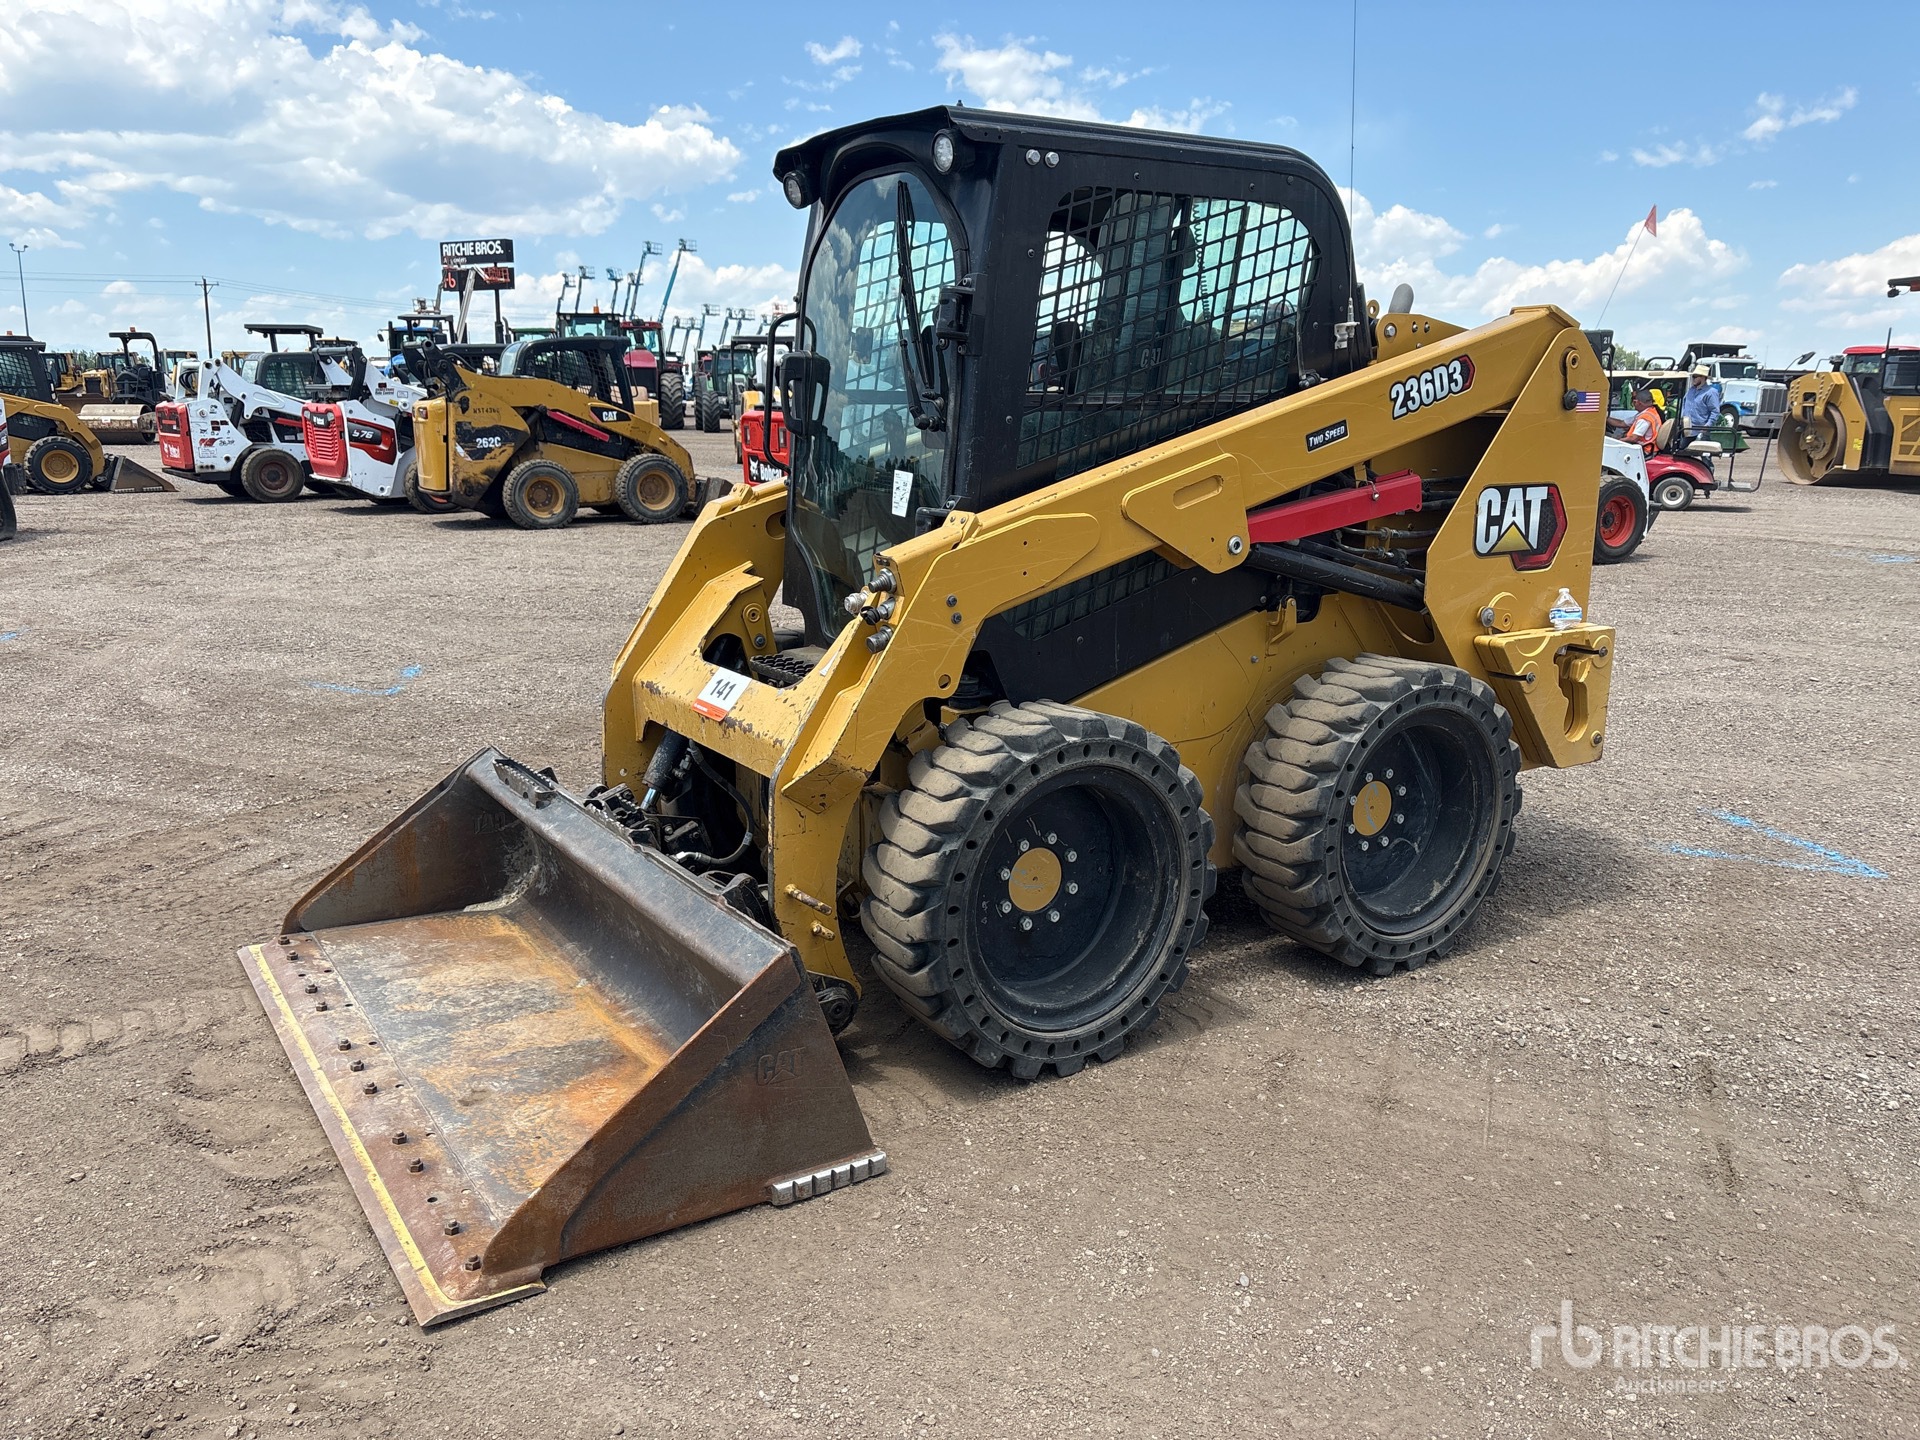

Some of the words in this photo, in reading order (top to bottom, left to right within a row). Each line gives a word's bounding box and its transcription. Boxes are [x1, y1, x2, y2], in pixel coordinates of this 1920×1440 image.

[442, 241, 474, 257] RITCHIE
[475, 240, 504, 256] BROS.
[1603, 336, 1611, 345] 21
[1390, 359, 1464, 418] 236D3
[602, 410, 618, 421] CAT
[352, 429, 374, 439] S76
[475, 436, 501, 449] 262C
[1476, 486, 1548, 554] CAT
[710, 678, 737, 701] 141
[757, 1046, 805, 1086] CAT
